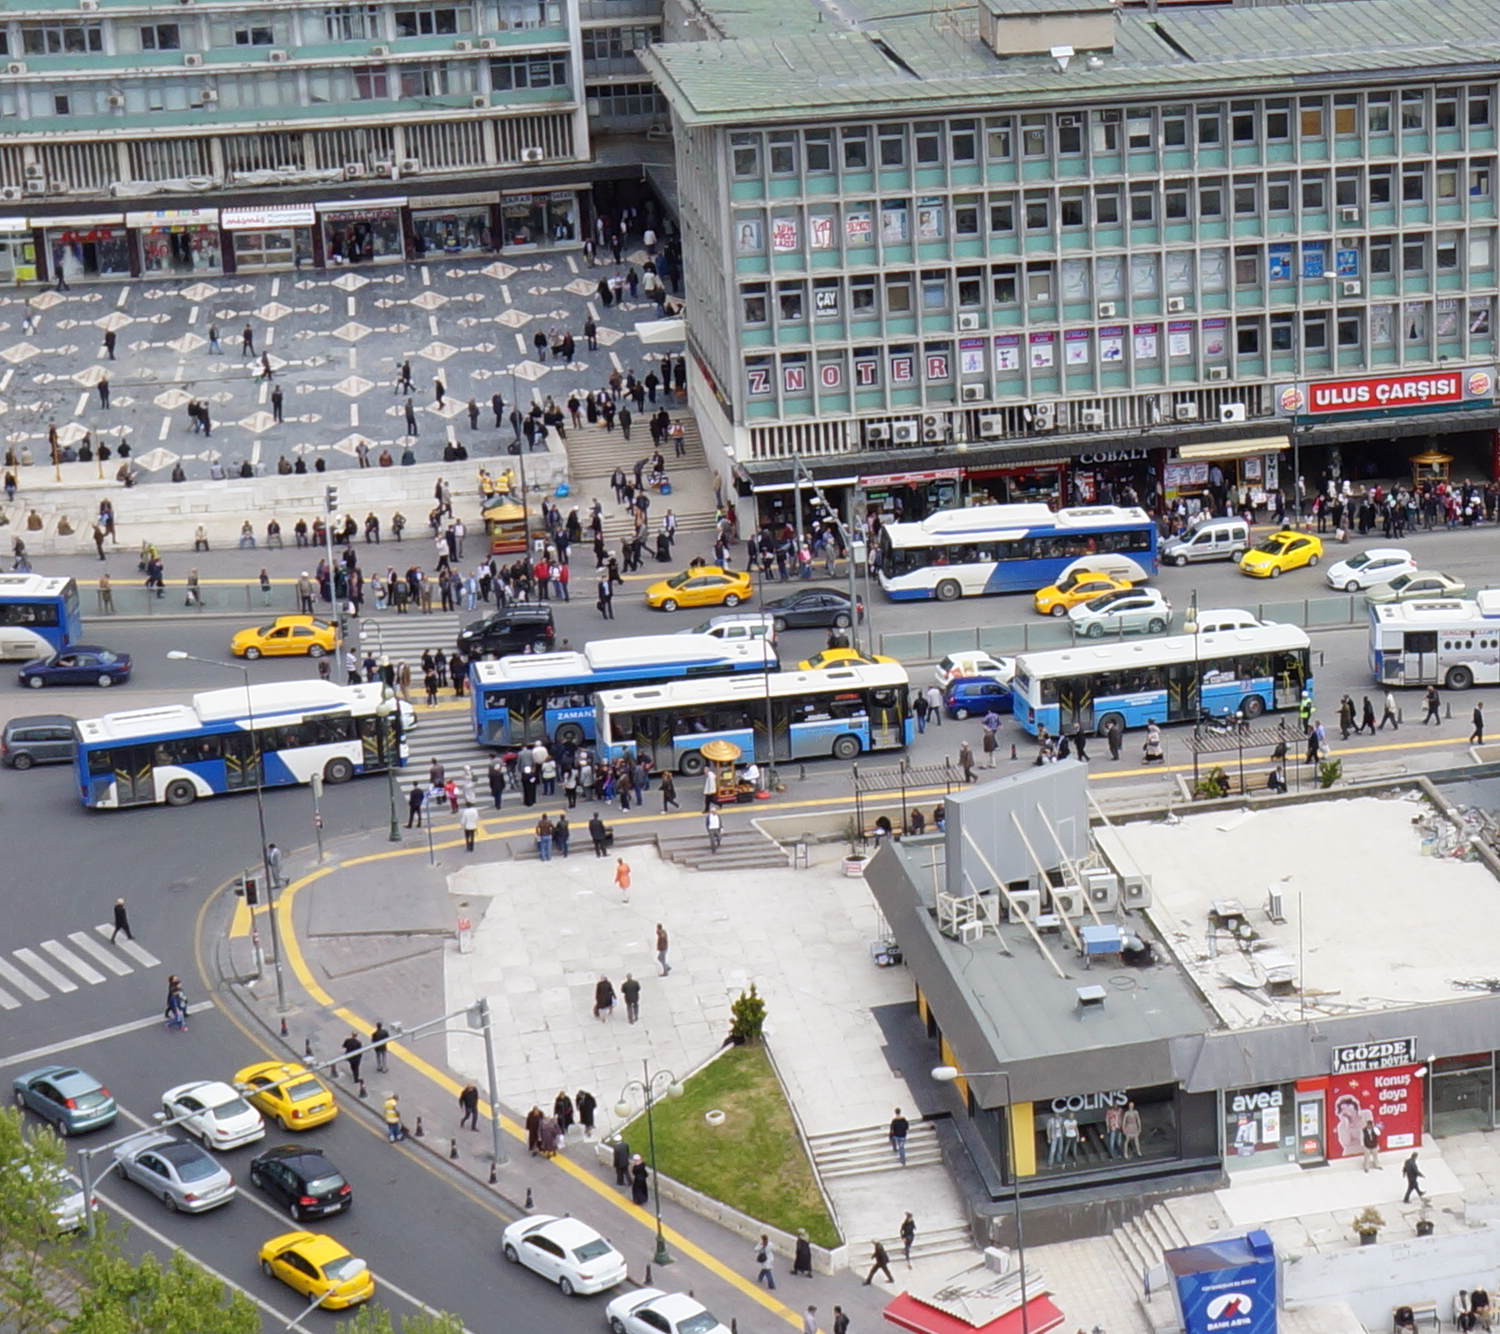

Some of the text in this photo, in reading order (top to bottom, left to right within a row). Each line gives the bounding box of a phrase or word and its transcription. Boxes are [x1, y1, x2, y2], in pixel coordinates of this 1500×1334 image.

[817, 292, 836, 309] ÇAY
[749, 356, 948, 394] 7. NOTER
[1316, 378, 1456, 405] ULUS ÇARŞISI
[1080, 446, 1150, 465] COBALT
[1342, 1042, 1407, 1062] GÖZDE
[1338, 1054, 1410, 1075] ALTIN ve DÖVİZ
[1374, 1073, 1411, 1088] Konuş
[1051, 1088, 1129, 1113] COLIN'S
[1232, 1090, 1283, 1112] avea
[1379, 1087, 1407, 1102] doya
[1379, 1101, 1407, 1116] doya
[1207, 1317, 1251, 1331] BANK ASYA
